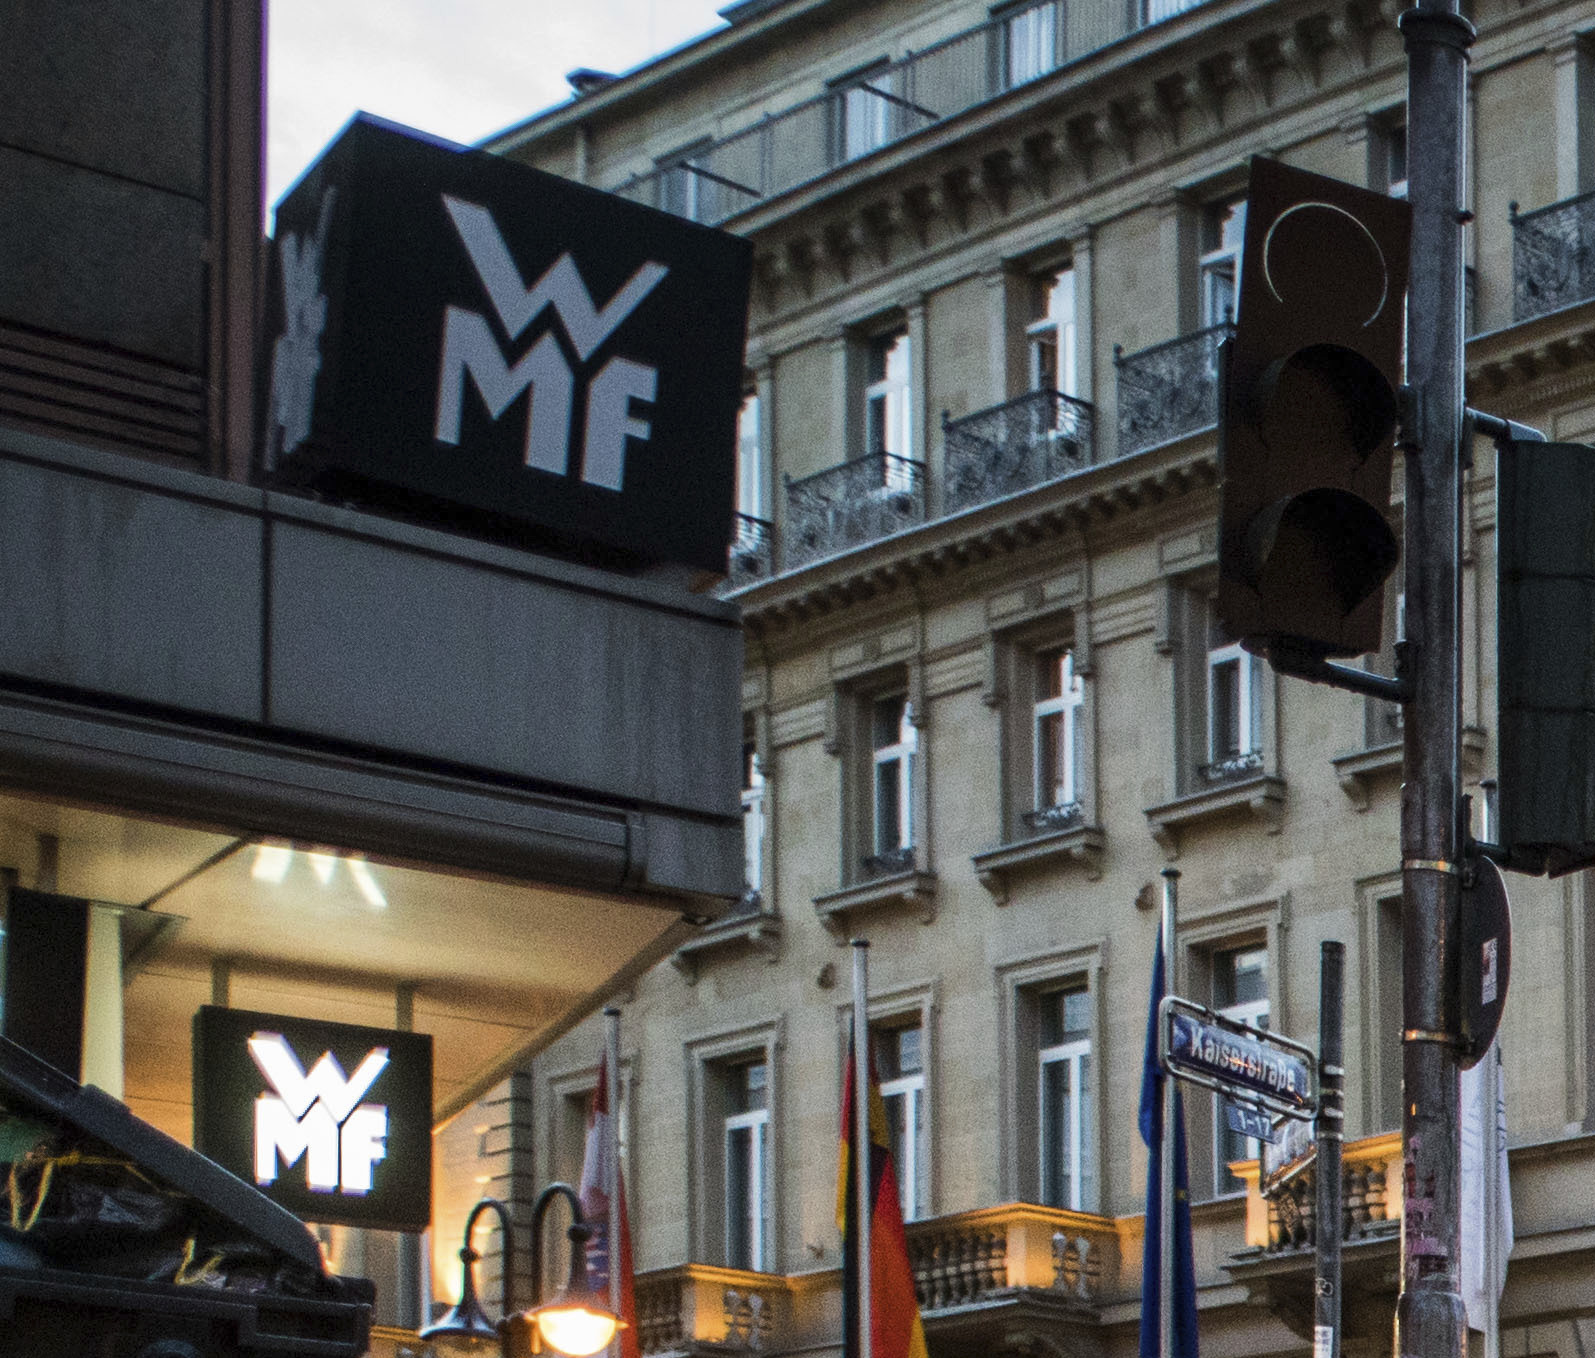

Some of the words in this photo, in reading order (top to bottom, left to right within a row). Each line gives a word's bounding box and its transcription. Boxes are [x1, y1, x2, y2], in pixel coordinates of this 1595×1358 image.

[434, 193, 668, 491] WMF
[247, 1032, 389, 1195] WMF
[1190, 1025, 1296, 1092] Kaiserstraße
[1237, 1109, 1272, 1137] 1-17
